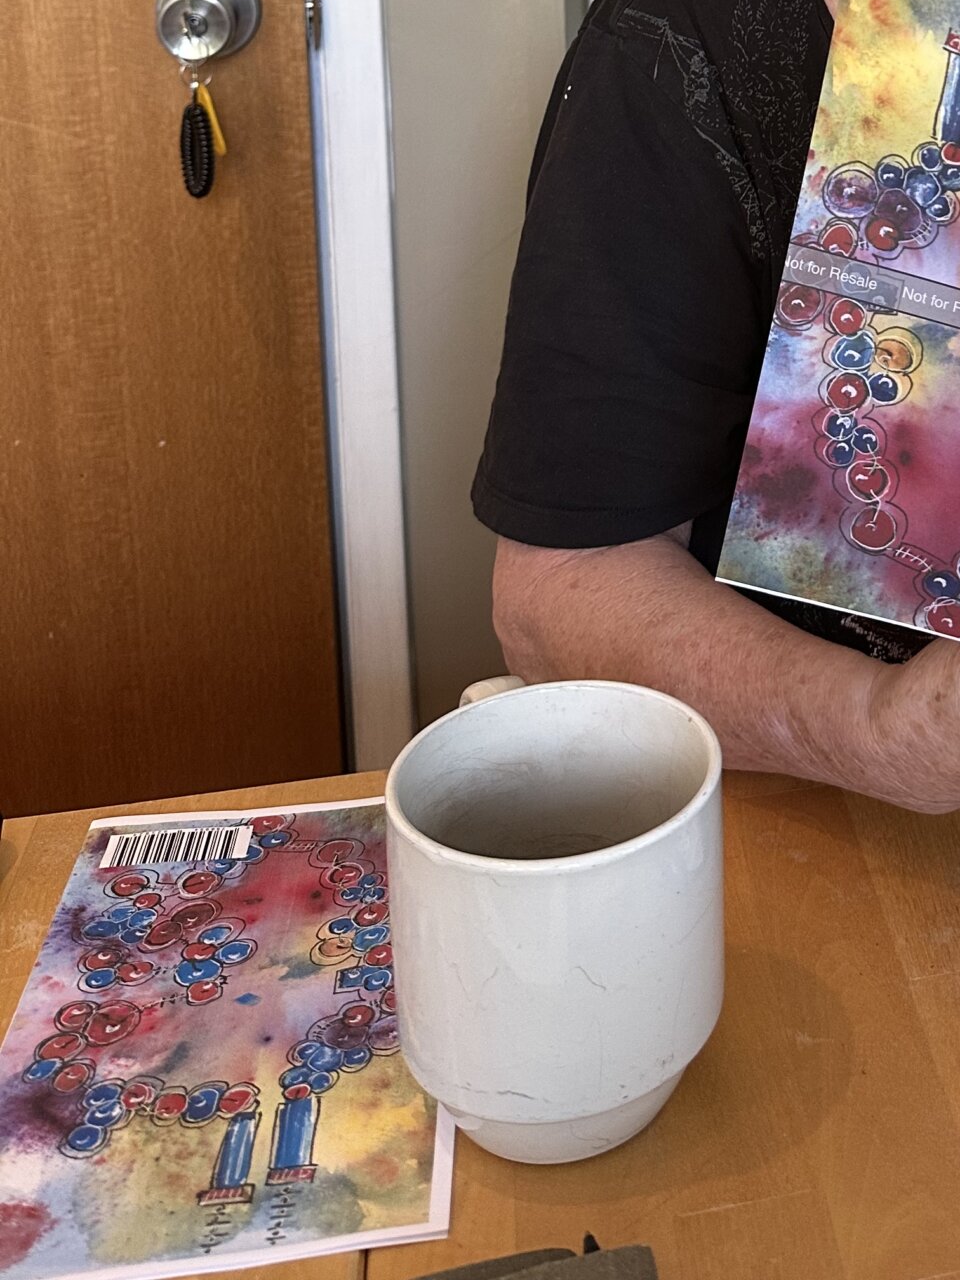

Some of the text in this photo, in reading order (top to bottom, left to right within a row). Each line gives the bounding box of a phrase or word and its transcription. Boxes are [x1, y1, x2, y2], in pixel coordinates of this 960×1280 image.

[807, 260, 827, 277] for
[829, 267, 879, 290] Resale
[902, 286, 927, 305] Not
[930, 293, 950, 310] for
